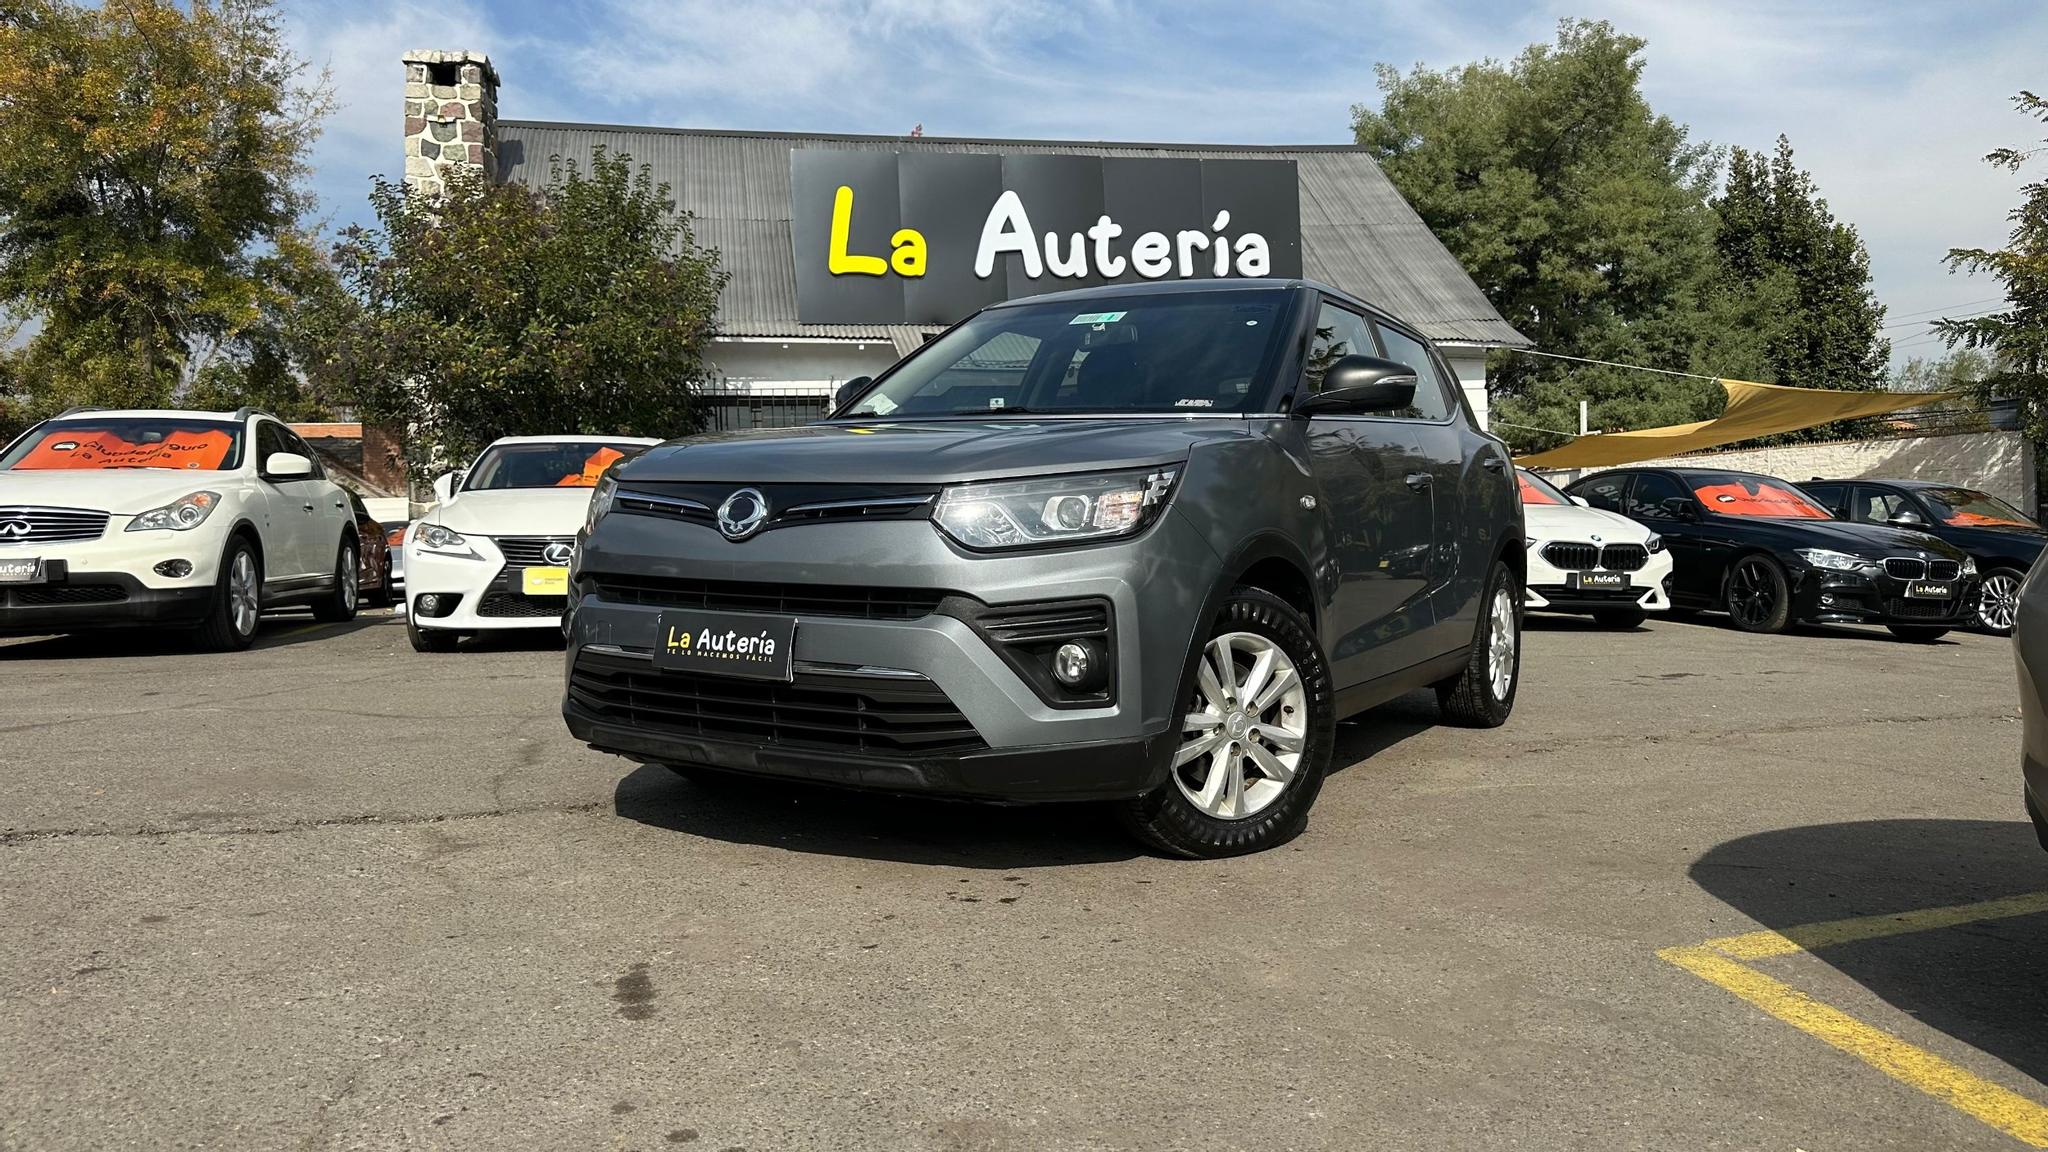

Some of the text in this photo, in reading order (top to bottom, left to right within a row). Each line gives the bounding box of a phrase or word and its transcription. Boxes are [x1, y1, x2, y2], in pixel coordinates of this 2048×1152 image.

[827, 185, 1271, 279] La Autería
[1583, 575, 1592, 583] La
[667, 625, 775, 655] La Autería
[697, 651, 740, 660] HACEMOS
[746, 654, 773, 663] FÁCIL
